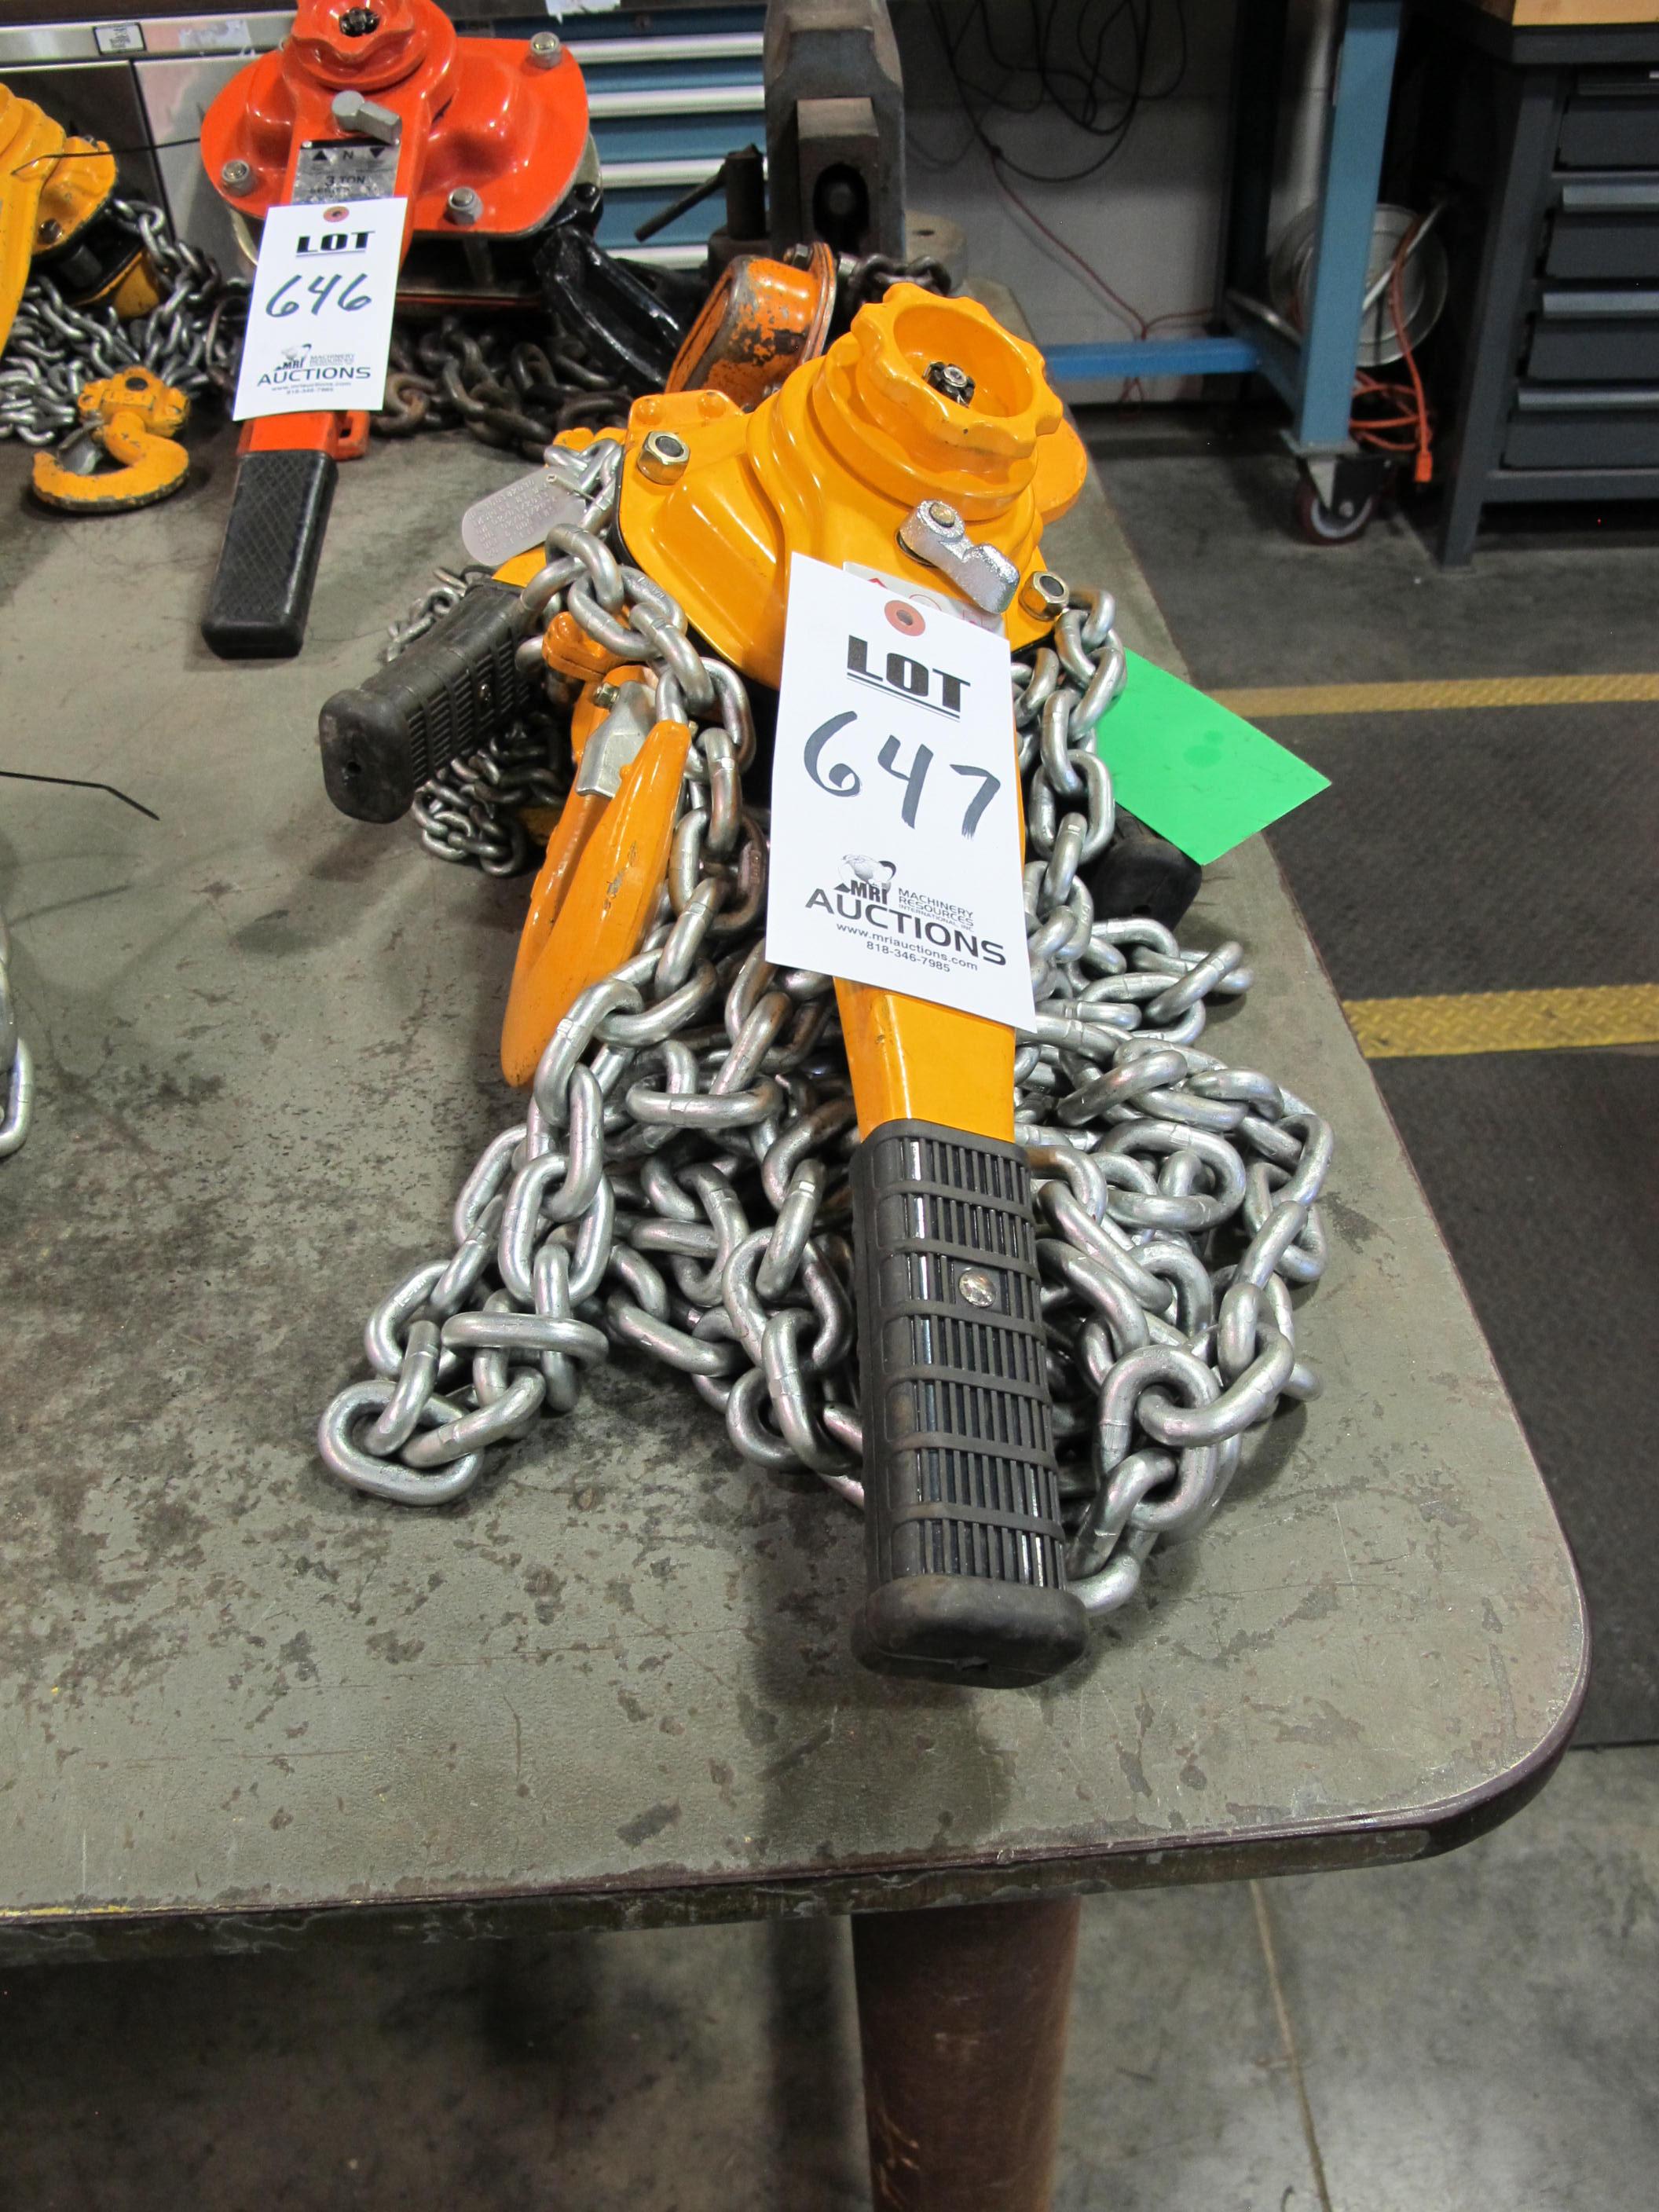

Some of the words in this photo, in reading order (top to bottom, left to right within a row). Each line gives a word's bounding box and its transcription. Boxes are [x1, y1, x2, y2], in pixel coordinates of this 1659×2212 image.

[339, 175, 365, 185] TON
[296, 230, 375, 255] LOT
[266, 273, 372, 317] 646
[257, 367, 372, 386] AUCTIONS
[847, 635, 971, 712] LOT
[804, 710, 1002, 840] 647
[850, 879, 889, 905] MRI
[898, 887, 974, 919] MACHINERY
[805, 888, 1007, 966] AUCTIONS
[898, 895, 974, 927] RESOURCES
[837, 923, 978, 972] www.mriauctions.com
[866, 940, 951, 973] 818-346-7985
